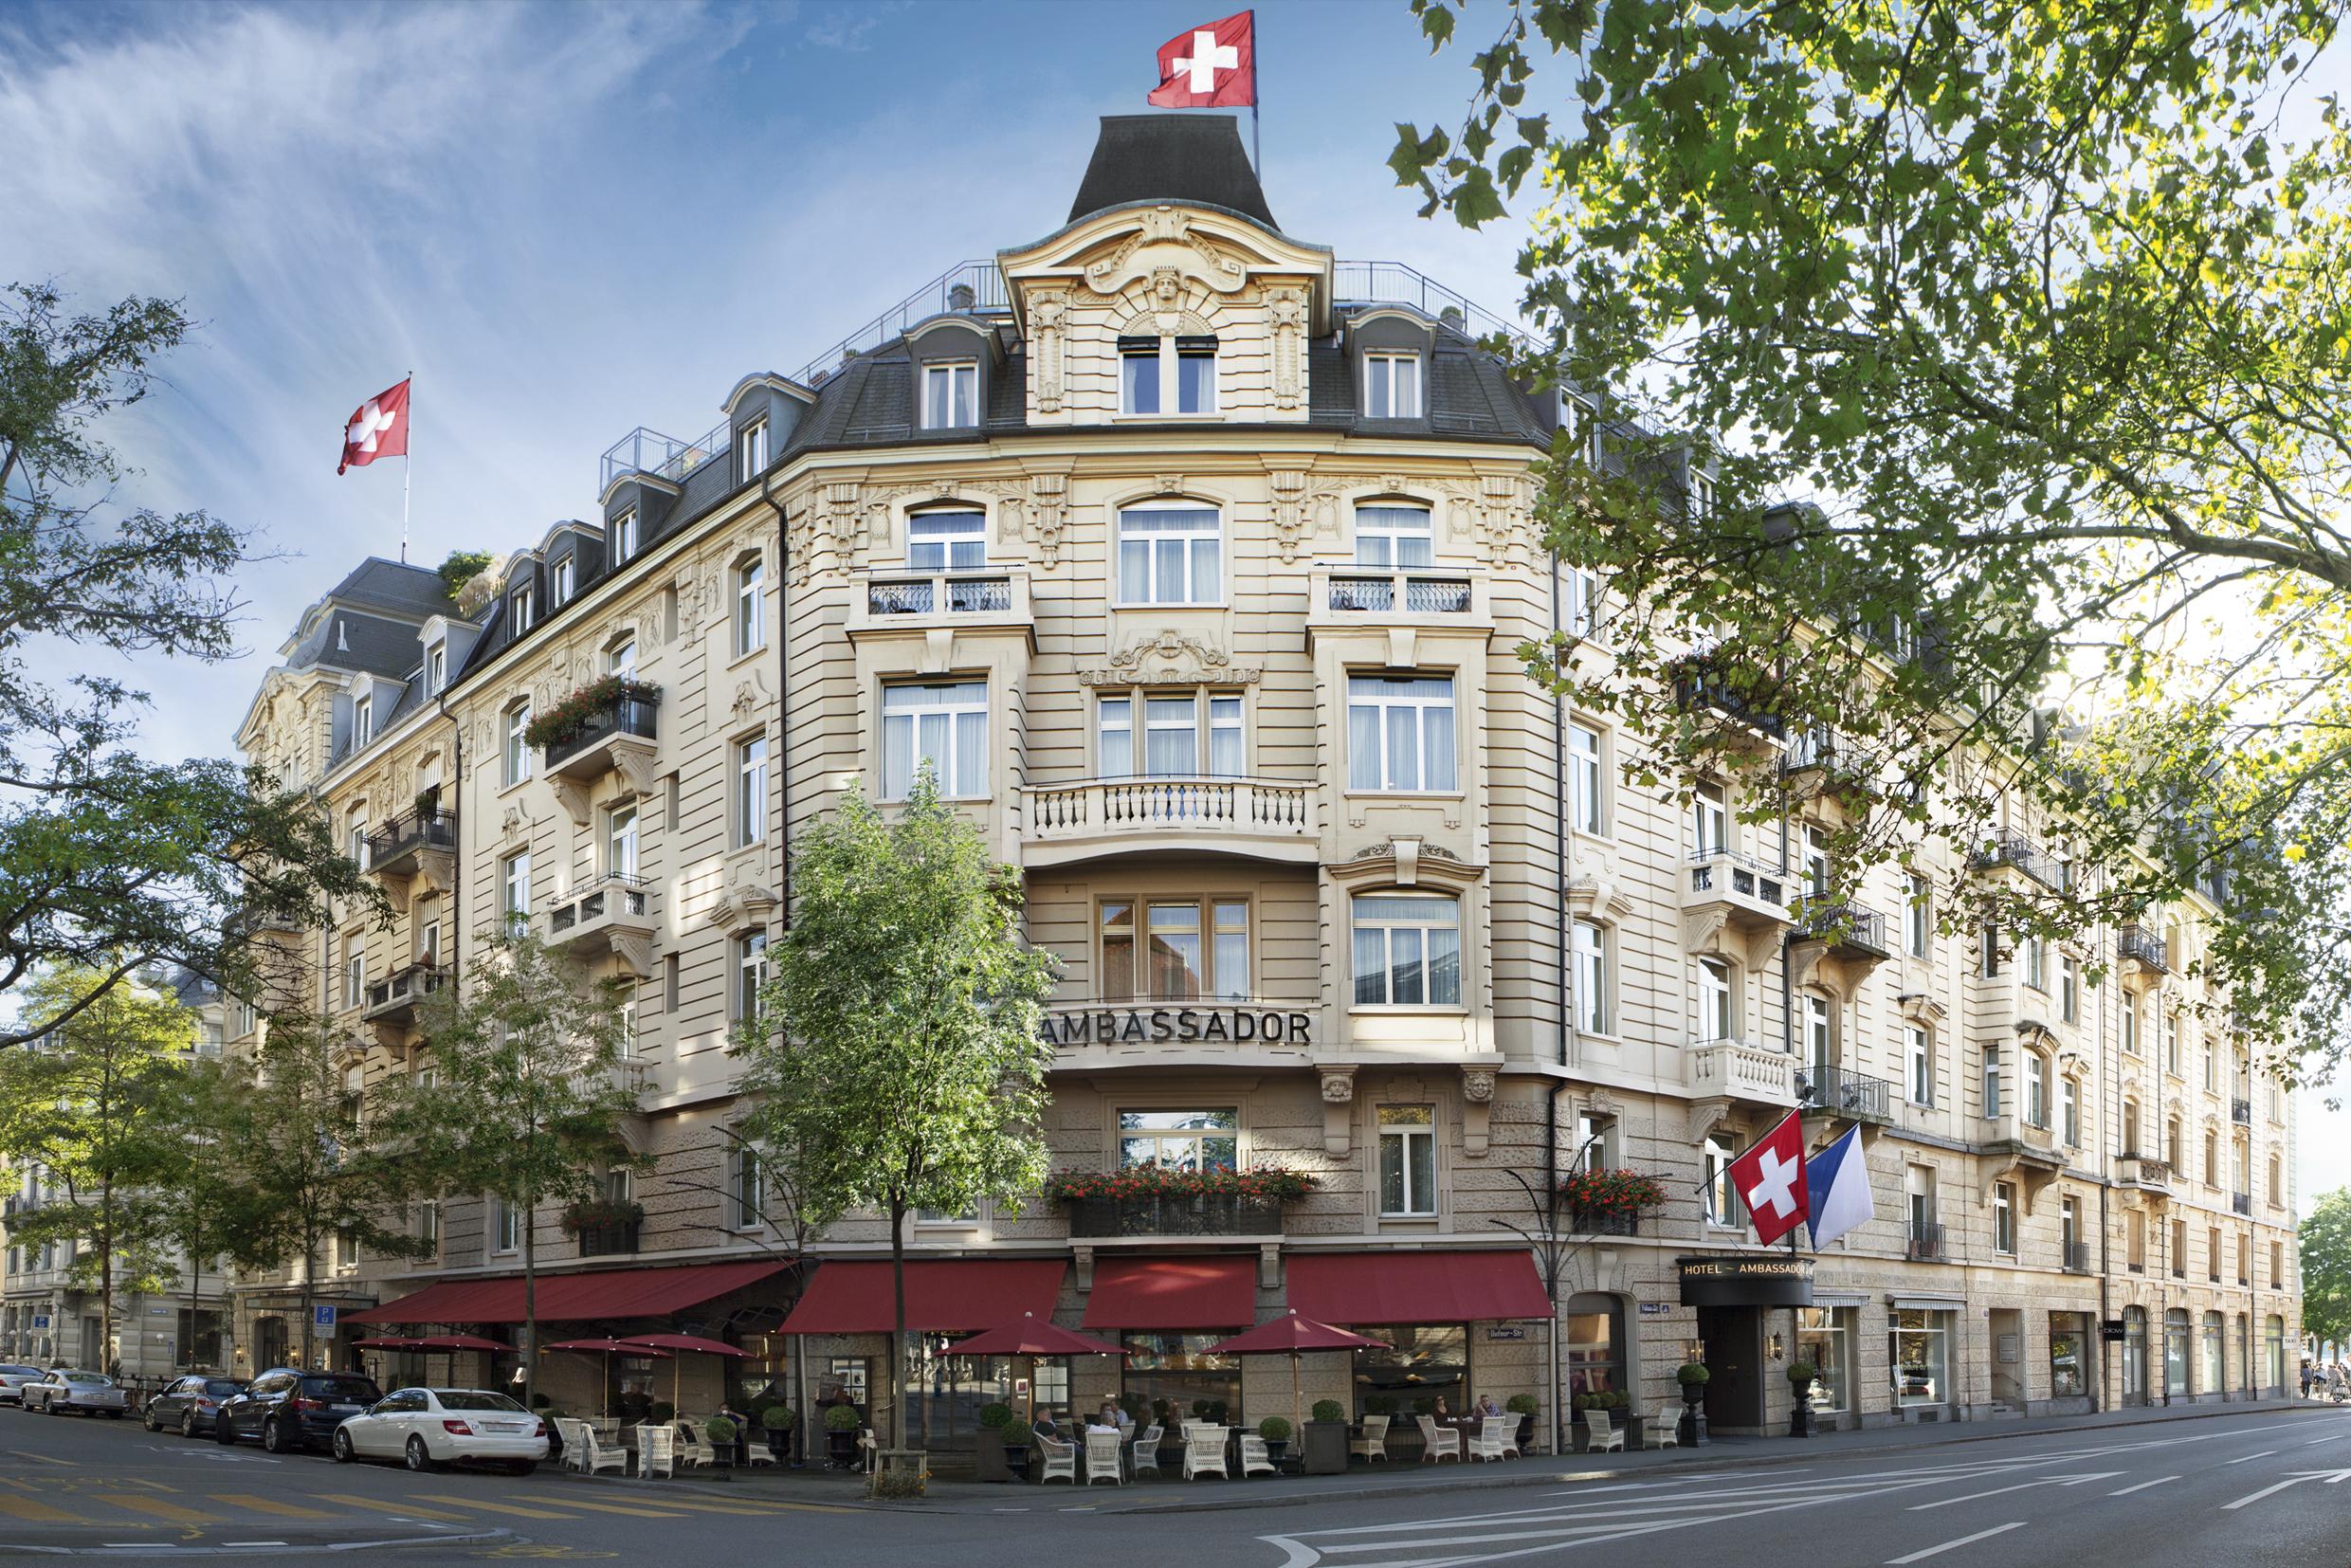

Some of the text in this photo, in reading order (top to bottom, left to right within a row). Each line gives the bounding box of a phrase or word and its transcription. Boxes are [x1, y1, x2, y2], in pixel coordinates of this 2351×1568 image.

[1037, 1011, 1312, 1045] AMBASSADOR
[1685, 1264, 1722, 1275] HOTEL
[1739, 1263, 1805, 1275] AMBASSADOR
